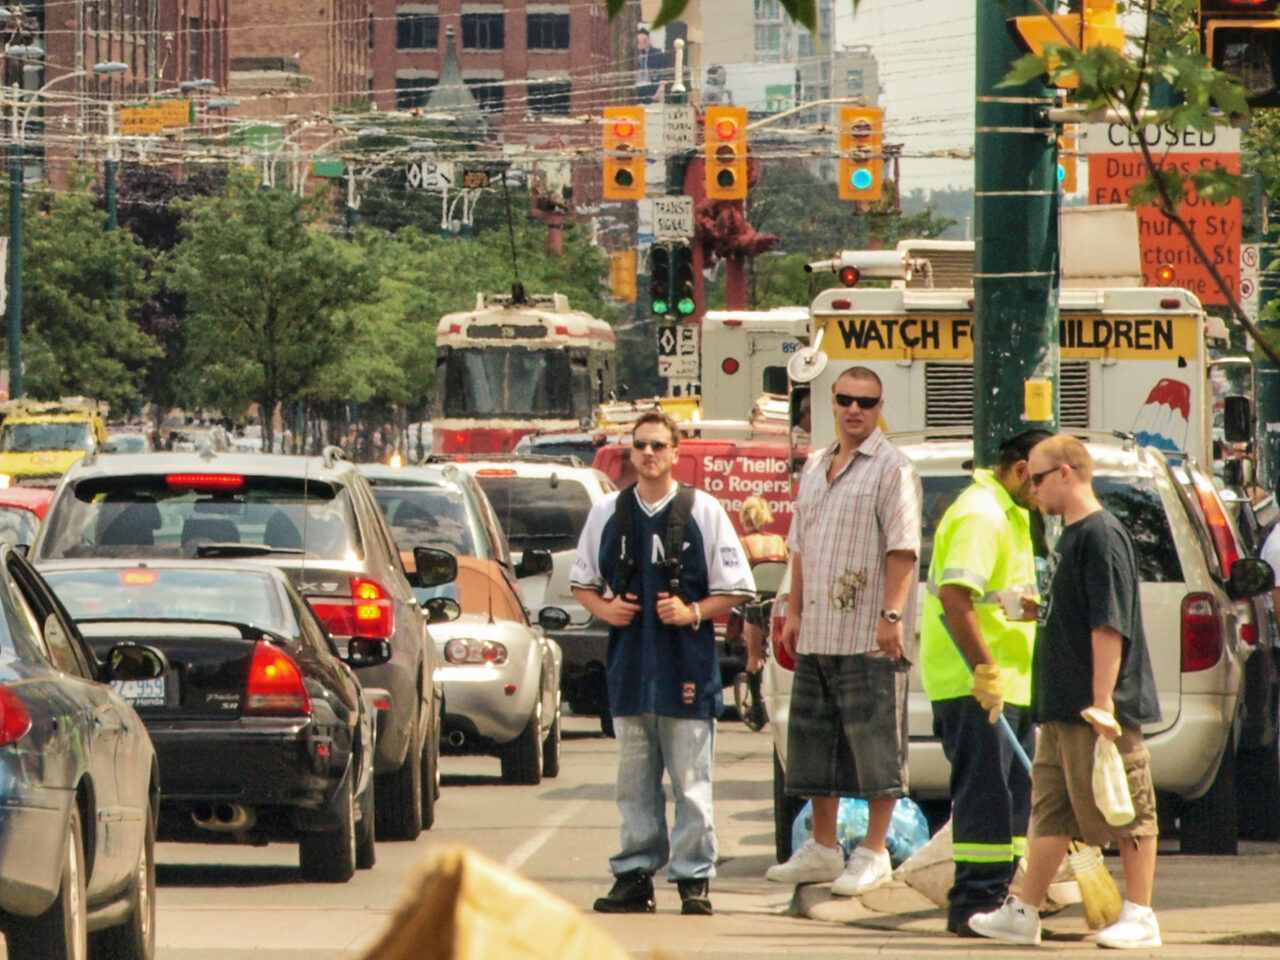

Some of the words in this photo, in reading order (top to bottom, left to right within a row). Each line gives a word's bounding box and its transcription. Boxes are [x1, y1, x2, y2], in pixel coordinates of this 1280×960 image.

[1206, 216, 1228, 236] St
[1214, 244, 1233, 265] St
[837, 319, 939, 349] WATCH
[1060, 319, 1173, 350] ILDREN
[782, 342, 799, 353] 89
[703, 456, 734, 476] Say
[704, 477, 724, 492] to
[728, 476, 790, 497] Rogers
